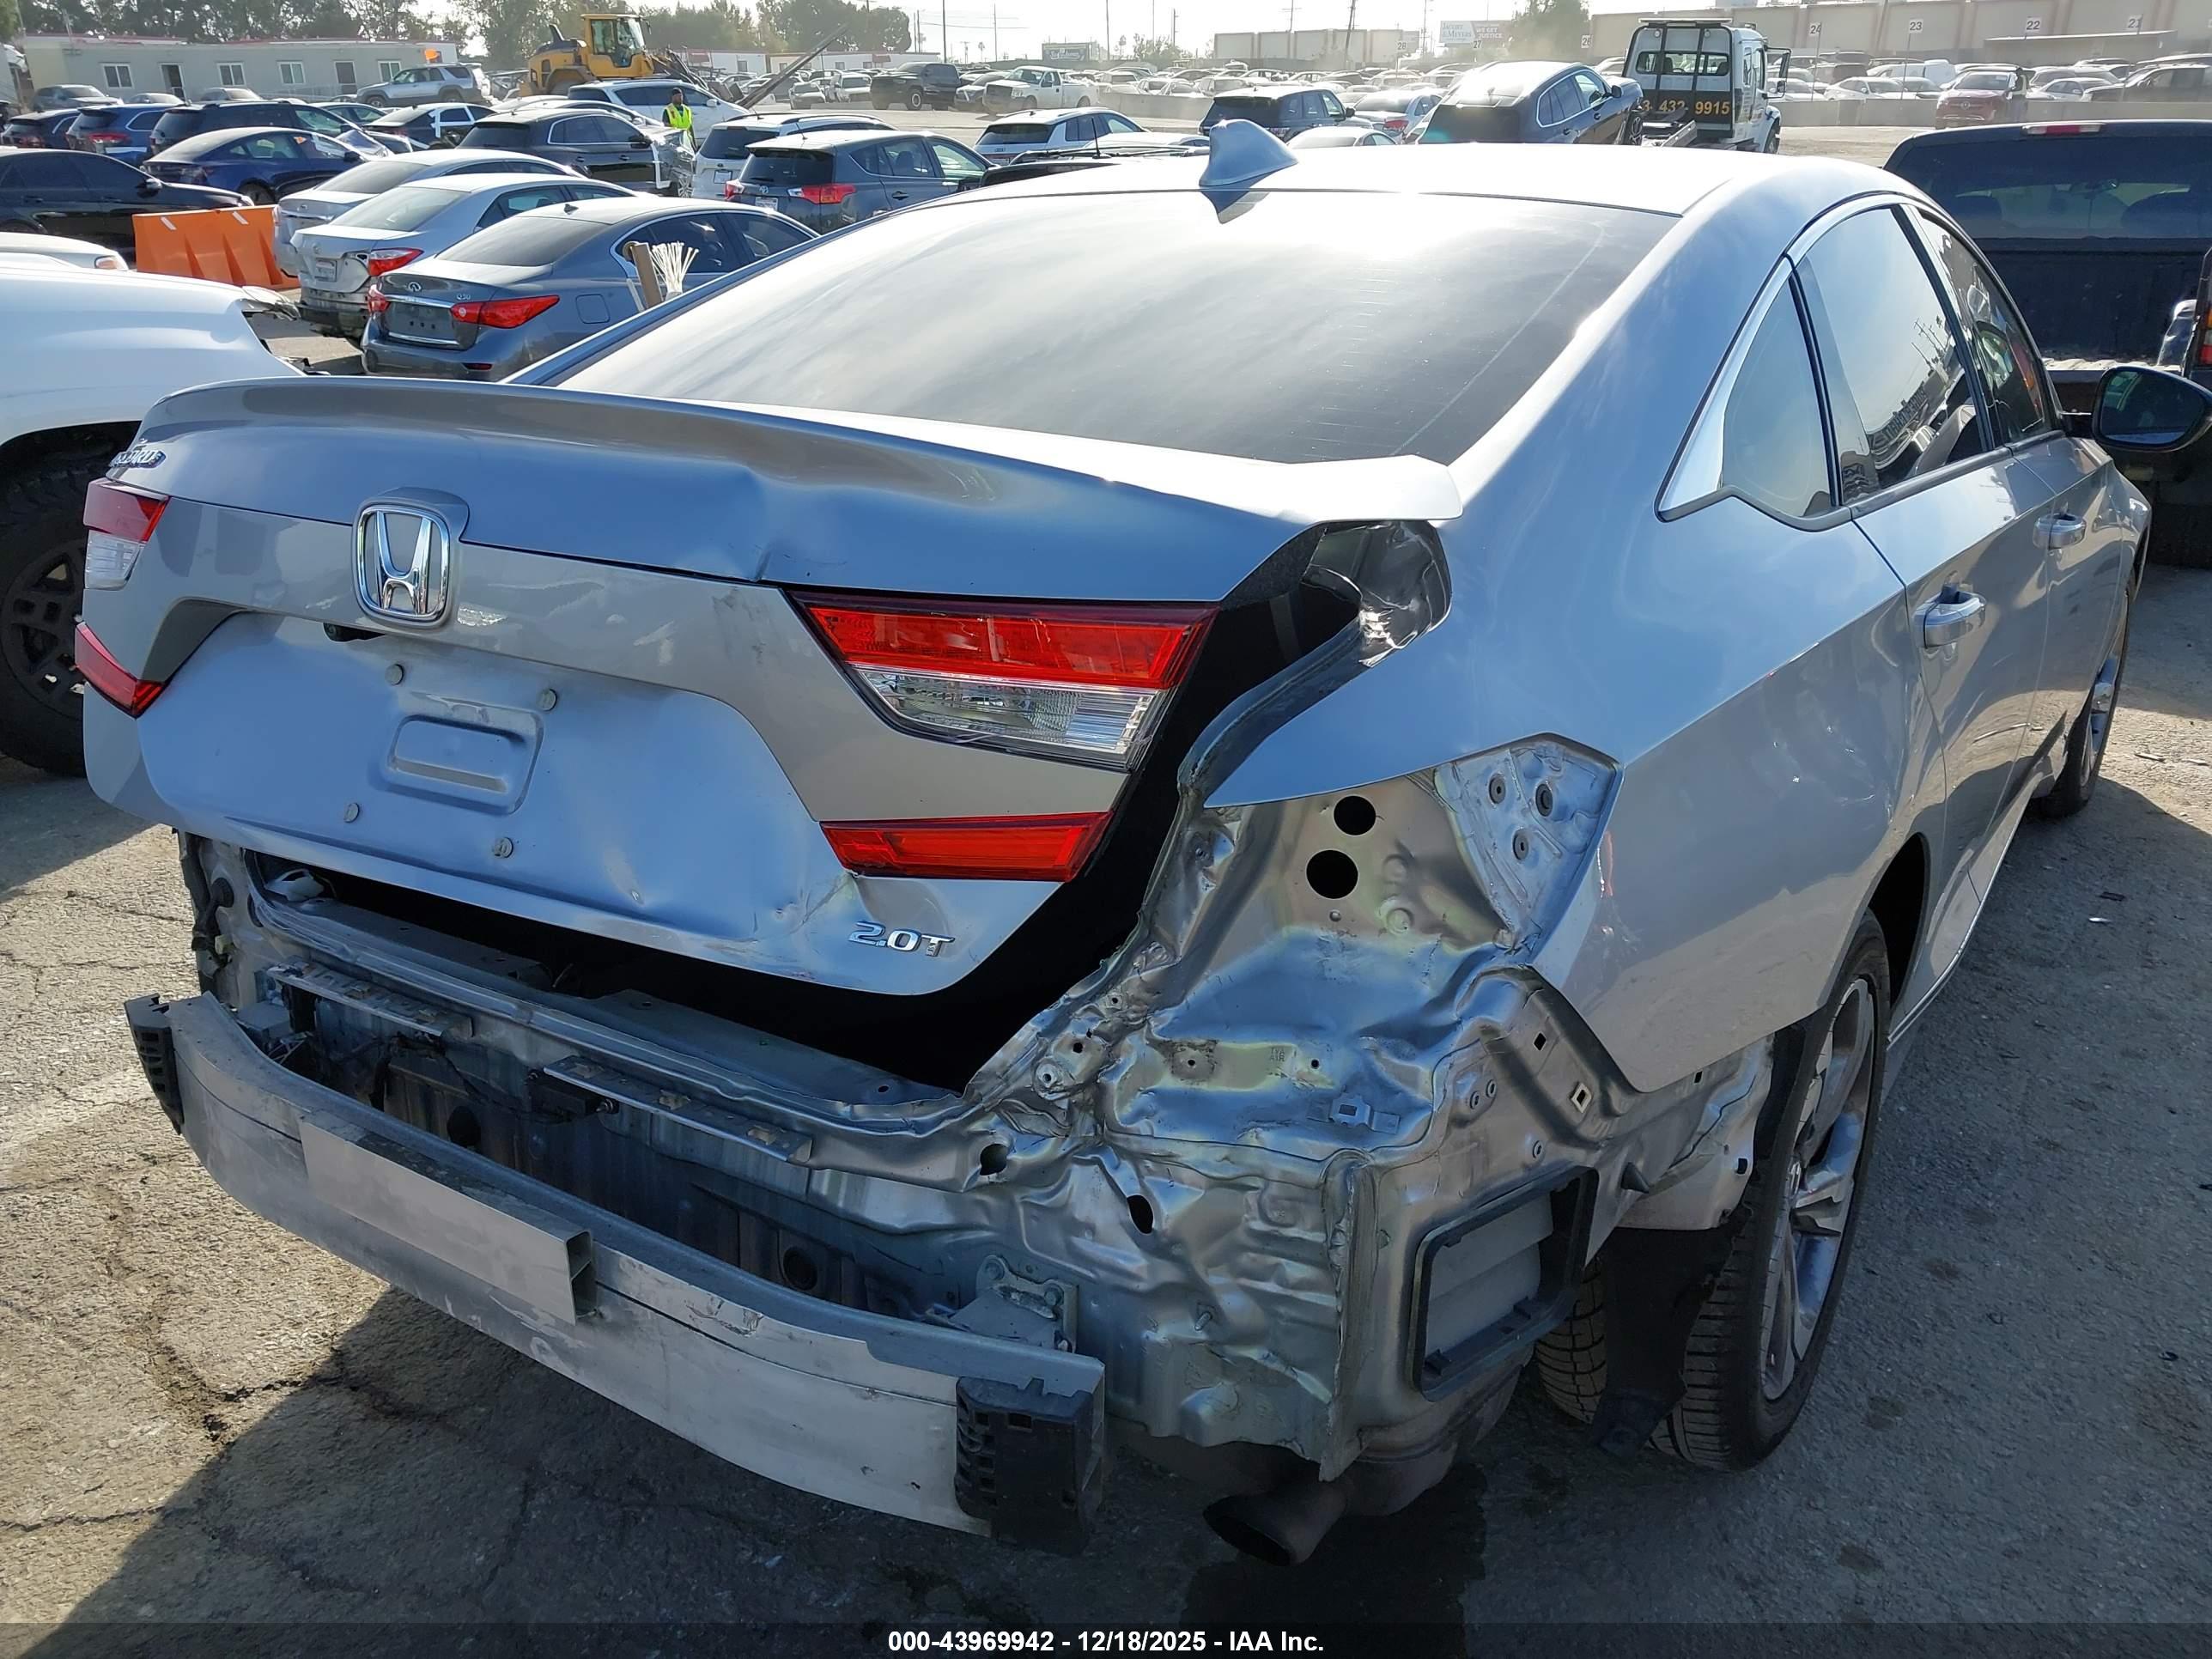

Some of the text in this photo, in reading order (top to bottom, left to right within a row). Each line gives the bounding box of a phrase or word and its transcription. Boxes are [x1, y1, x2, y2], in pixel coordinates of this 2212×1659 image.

[1909, 21, 1923, 31] 23
[2026, 20, 2040, 30] 22
[1474, 40, 1482, 49] 27
[1695, 100, 1730, 115] 9915
[848, 921, 956, 957] 2.0T
